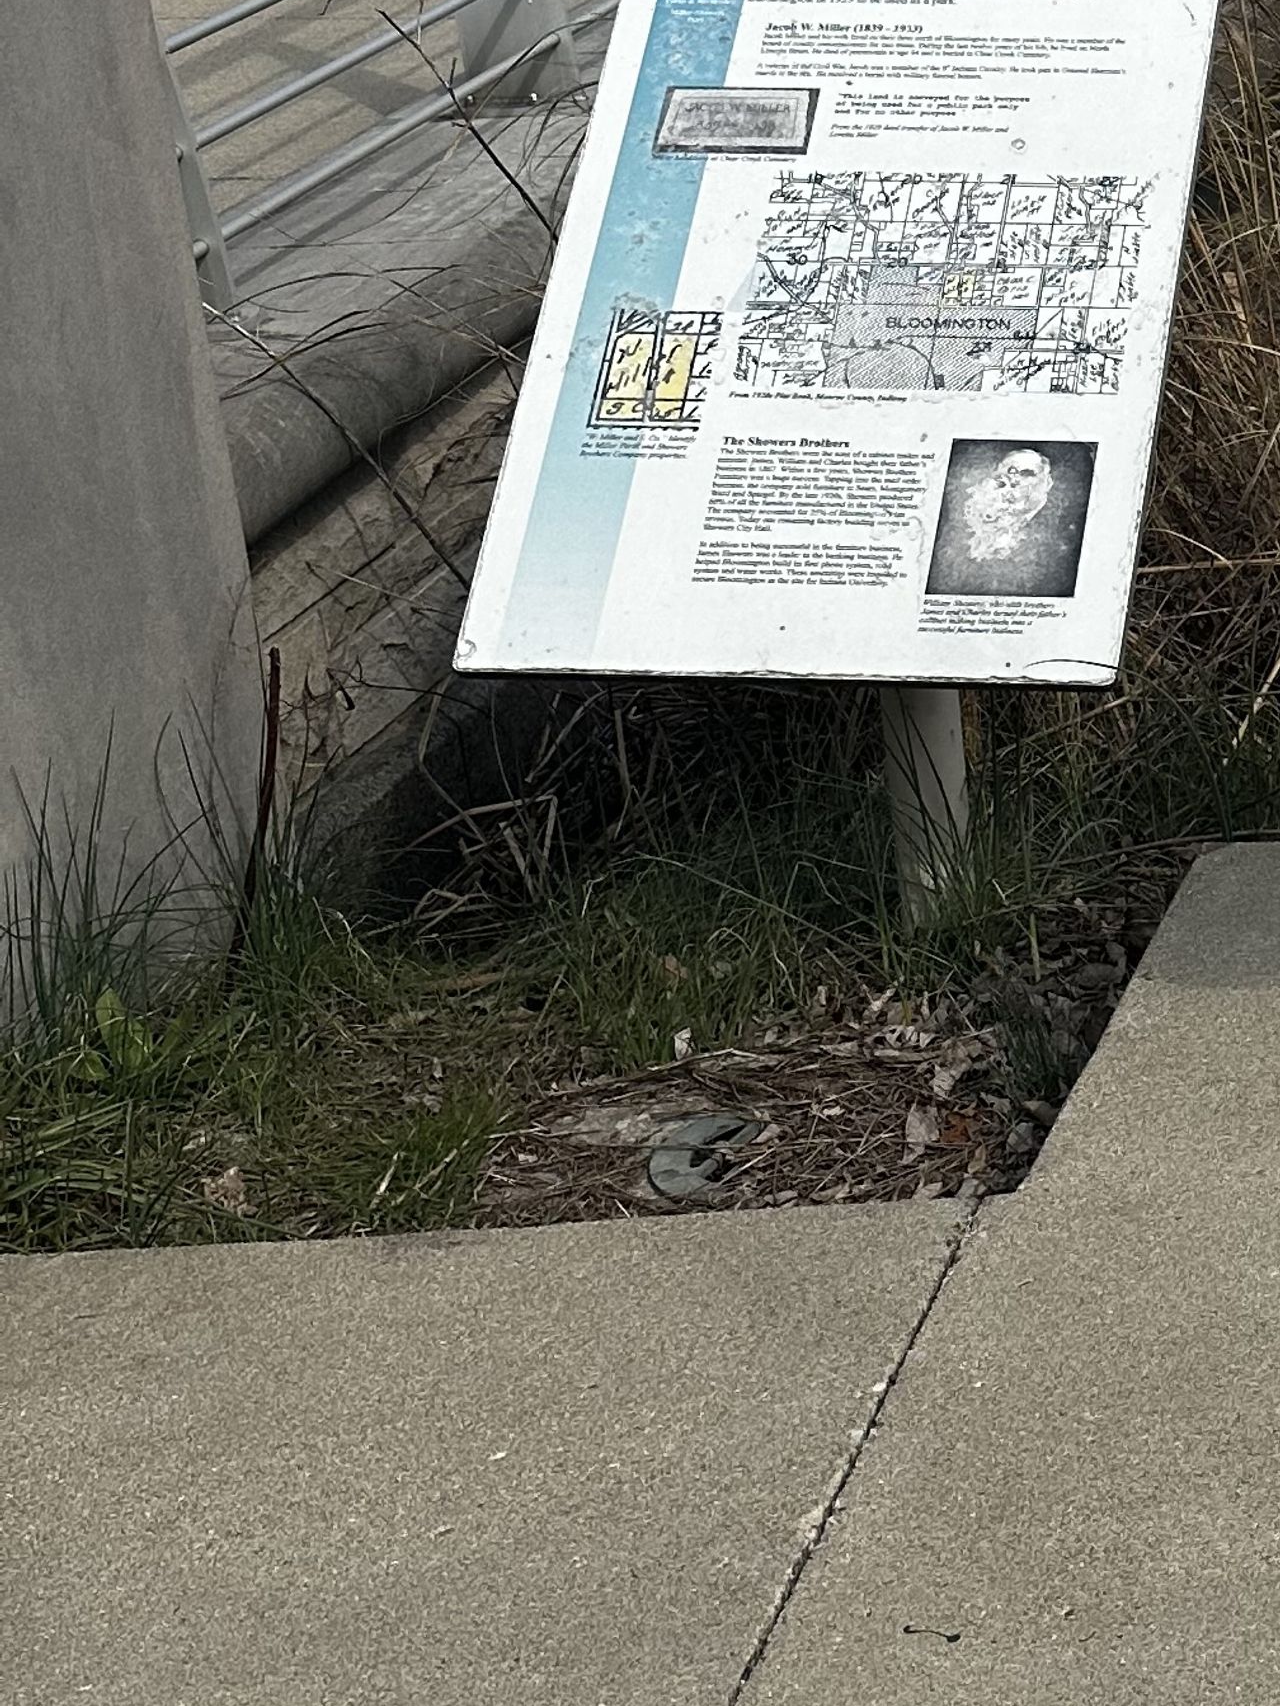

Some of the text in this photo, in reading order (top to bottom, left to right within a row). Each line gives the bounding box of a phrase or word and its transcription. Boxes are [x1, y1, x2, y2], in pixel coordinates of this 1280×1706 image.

[817, 23, 852, 32] Miller
[886, 317, 1011, 330] BLOOMINGTON
[723, 436, 850, 448] The Showers Brothers
